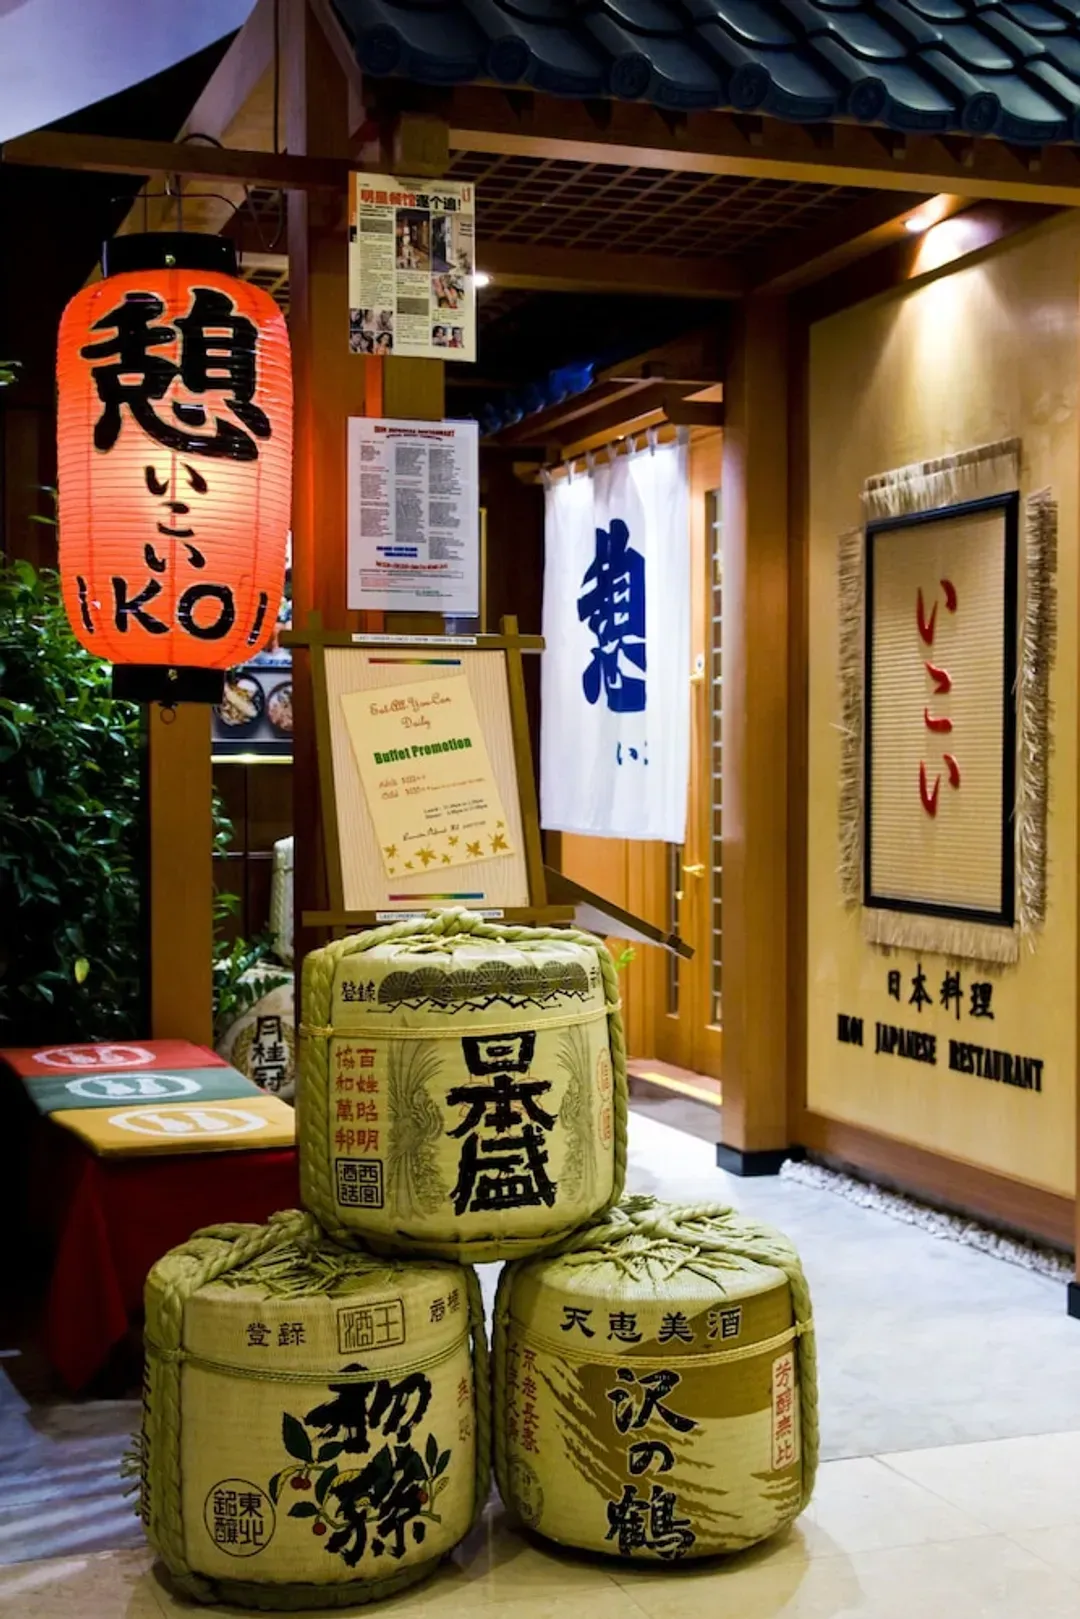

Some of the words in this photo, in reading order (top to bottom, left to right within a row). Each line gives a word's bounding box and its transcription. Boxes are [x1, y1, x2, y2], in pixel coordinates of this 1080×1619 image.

[144, 462, 208, 573] いこい
[401, 715, 430, 730] Daily
[916, 579, 960, 819] いこい
[373, 747, 411, 765] Buffet
[411, 737, 472, 758] Promotion
[887, 962, 995, 1020] 日本料理
[251, 1015, 287, 1092] 月桂冠
[875, 1021, 937, 1066] JAPANESE
[949, 1039, 1044, 1093] RESTAURANT
[445, 1030, 558, 1216] 日本盛
[560, 1304, 743, 1344] 天恵美酒
[604, 1366, 700, 1561] 沢の鶴
